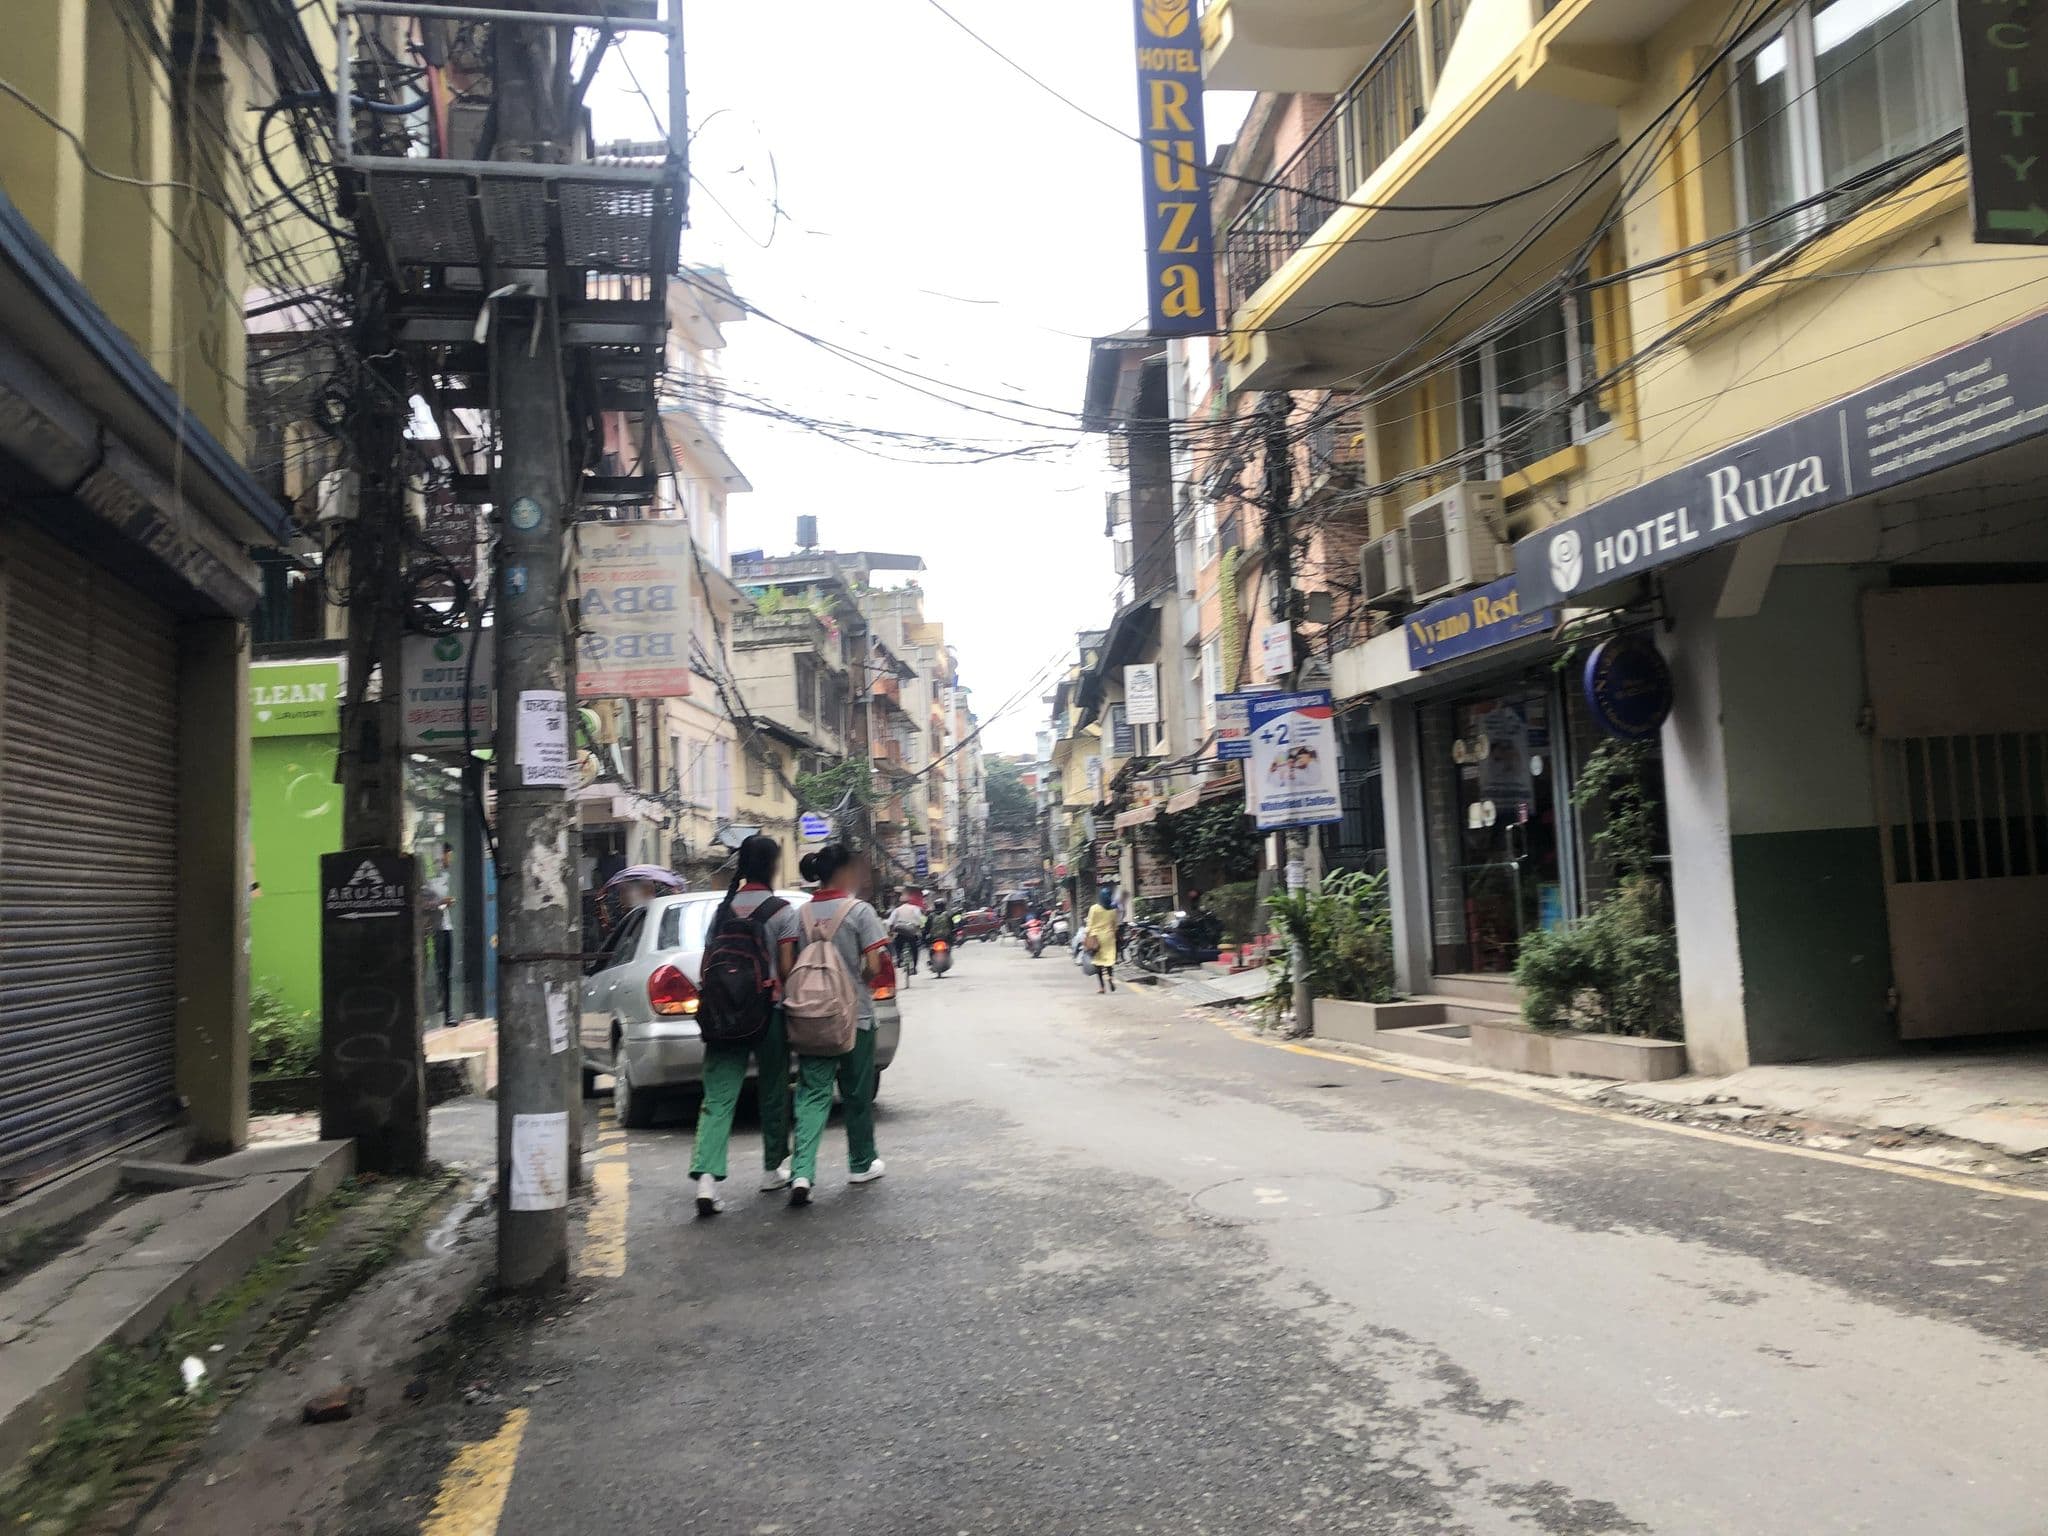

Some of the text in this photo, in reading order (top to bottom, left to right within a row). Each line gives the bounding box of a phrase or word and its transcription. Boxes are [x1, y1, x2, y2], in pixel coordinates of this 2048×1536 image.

[1138, 48, 1199, 72] HOTEL
[1593, 455, 1830, 574] HOTEL Ruza
[423, 668, 470, 682] HOTE
[250, 683, 328, 705] LEAN
[1260, 724, 1289, 745] +2
[326, 885, 405, 901] ARUSHI
